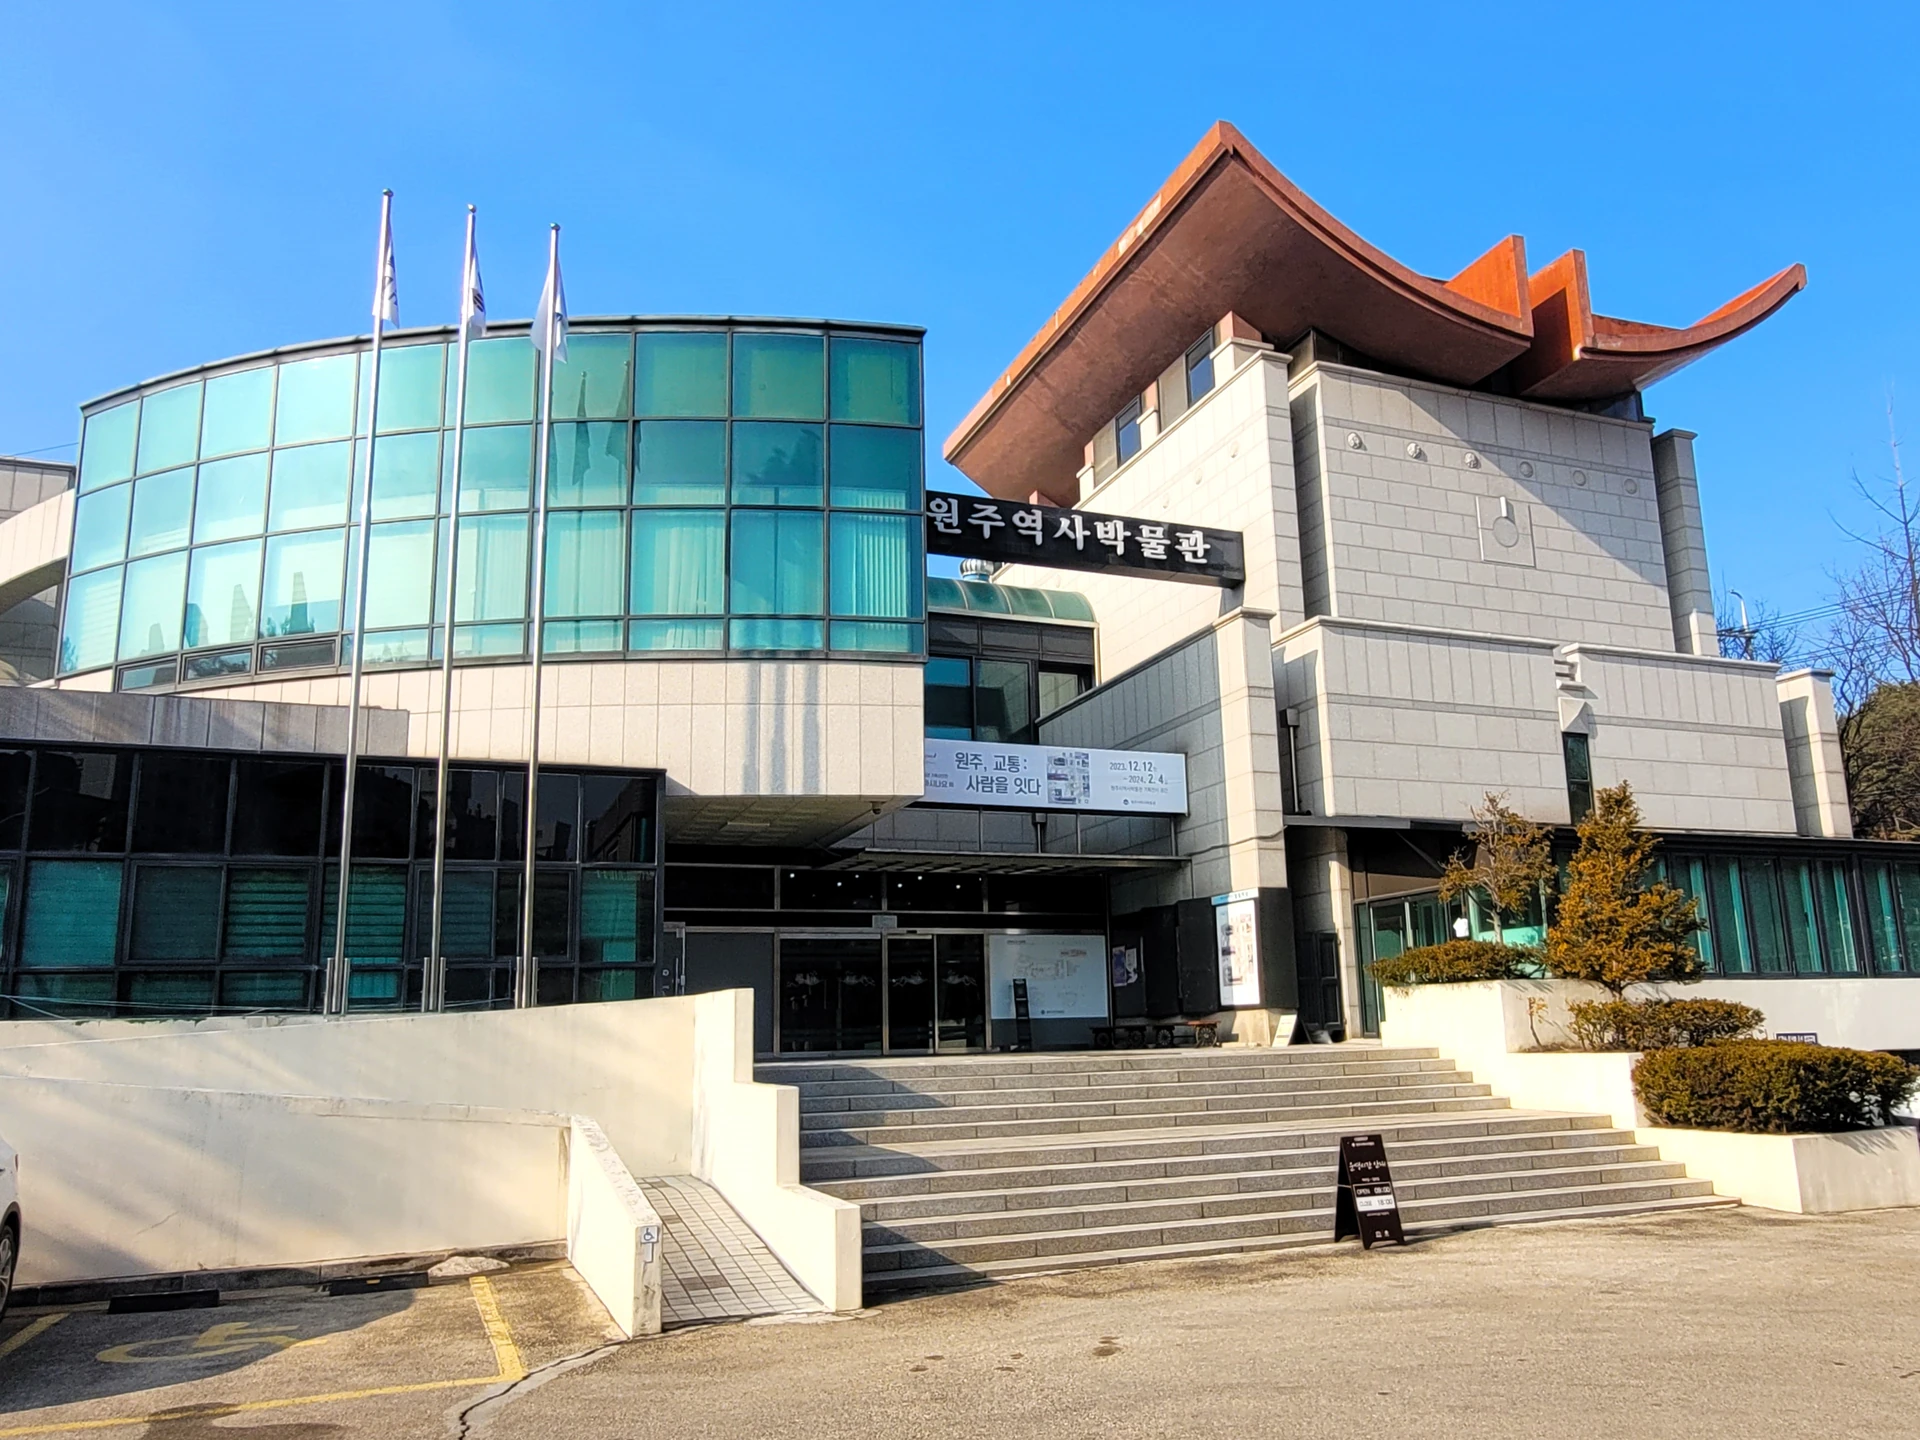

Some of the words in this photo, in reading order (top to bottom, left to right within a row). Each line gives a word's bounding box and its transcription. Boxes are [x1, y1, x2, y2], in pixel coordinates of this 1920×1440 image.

[926, 497, 1211, 565] 원주역사박물관
[955, 751, 987, 772] 원주,
[966, 775, 1008, 794] 사람을
[1014, 778, 1041, 795] 잇다
